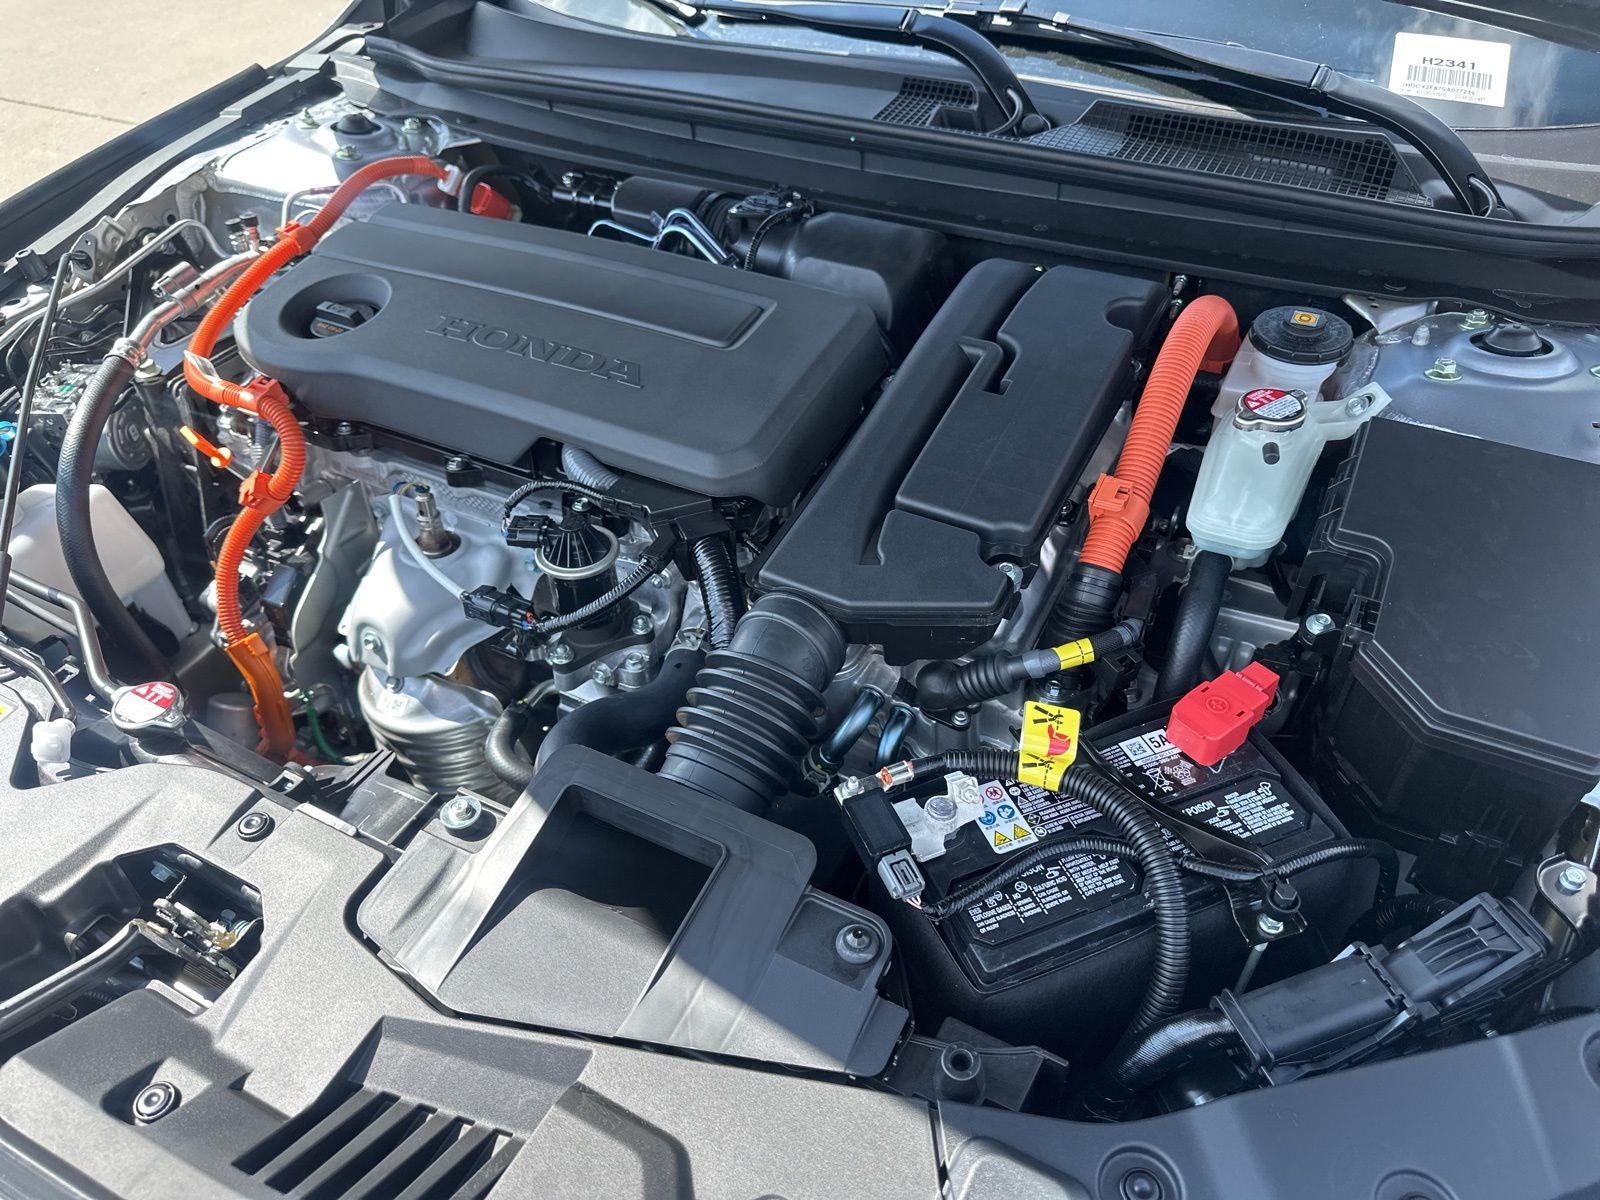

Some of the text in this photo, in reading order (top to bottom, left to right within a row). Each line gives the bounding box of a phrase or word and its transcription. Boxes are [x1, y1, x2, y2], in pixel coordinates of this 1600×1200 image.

[1422, 56, 1476, 70] H2341
[425, 315, 644, 389] HONDA
[1187, 800, 1216, 817] POISON
[968, 907, 982, 915] EYES
[972, 909, 997, 921] EXPLOSIVE
